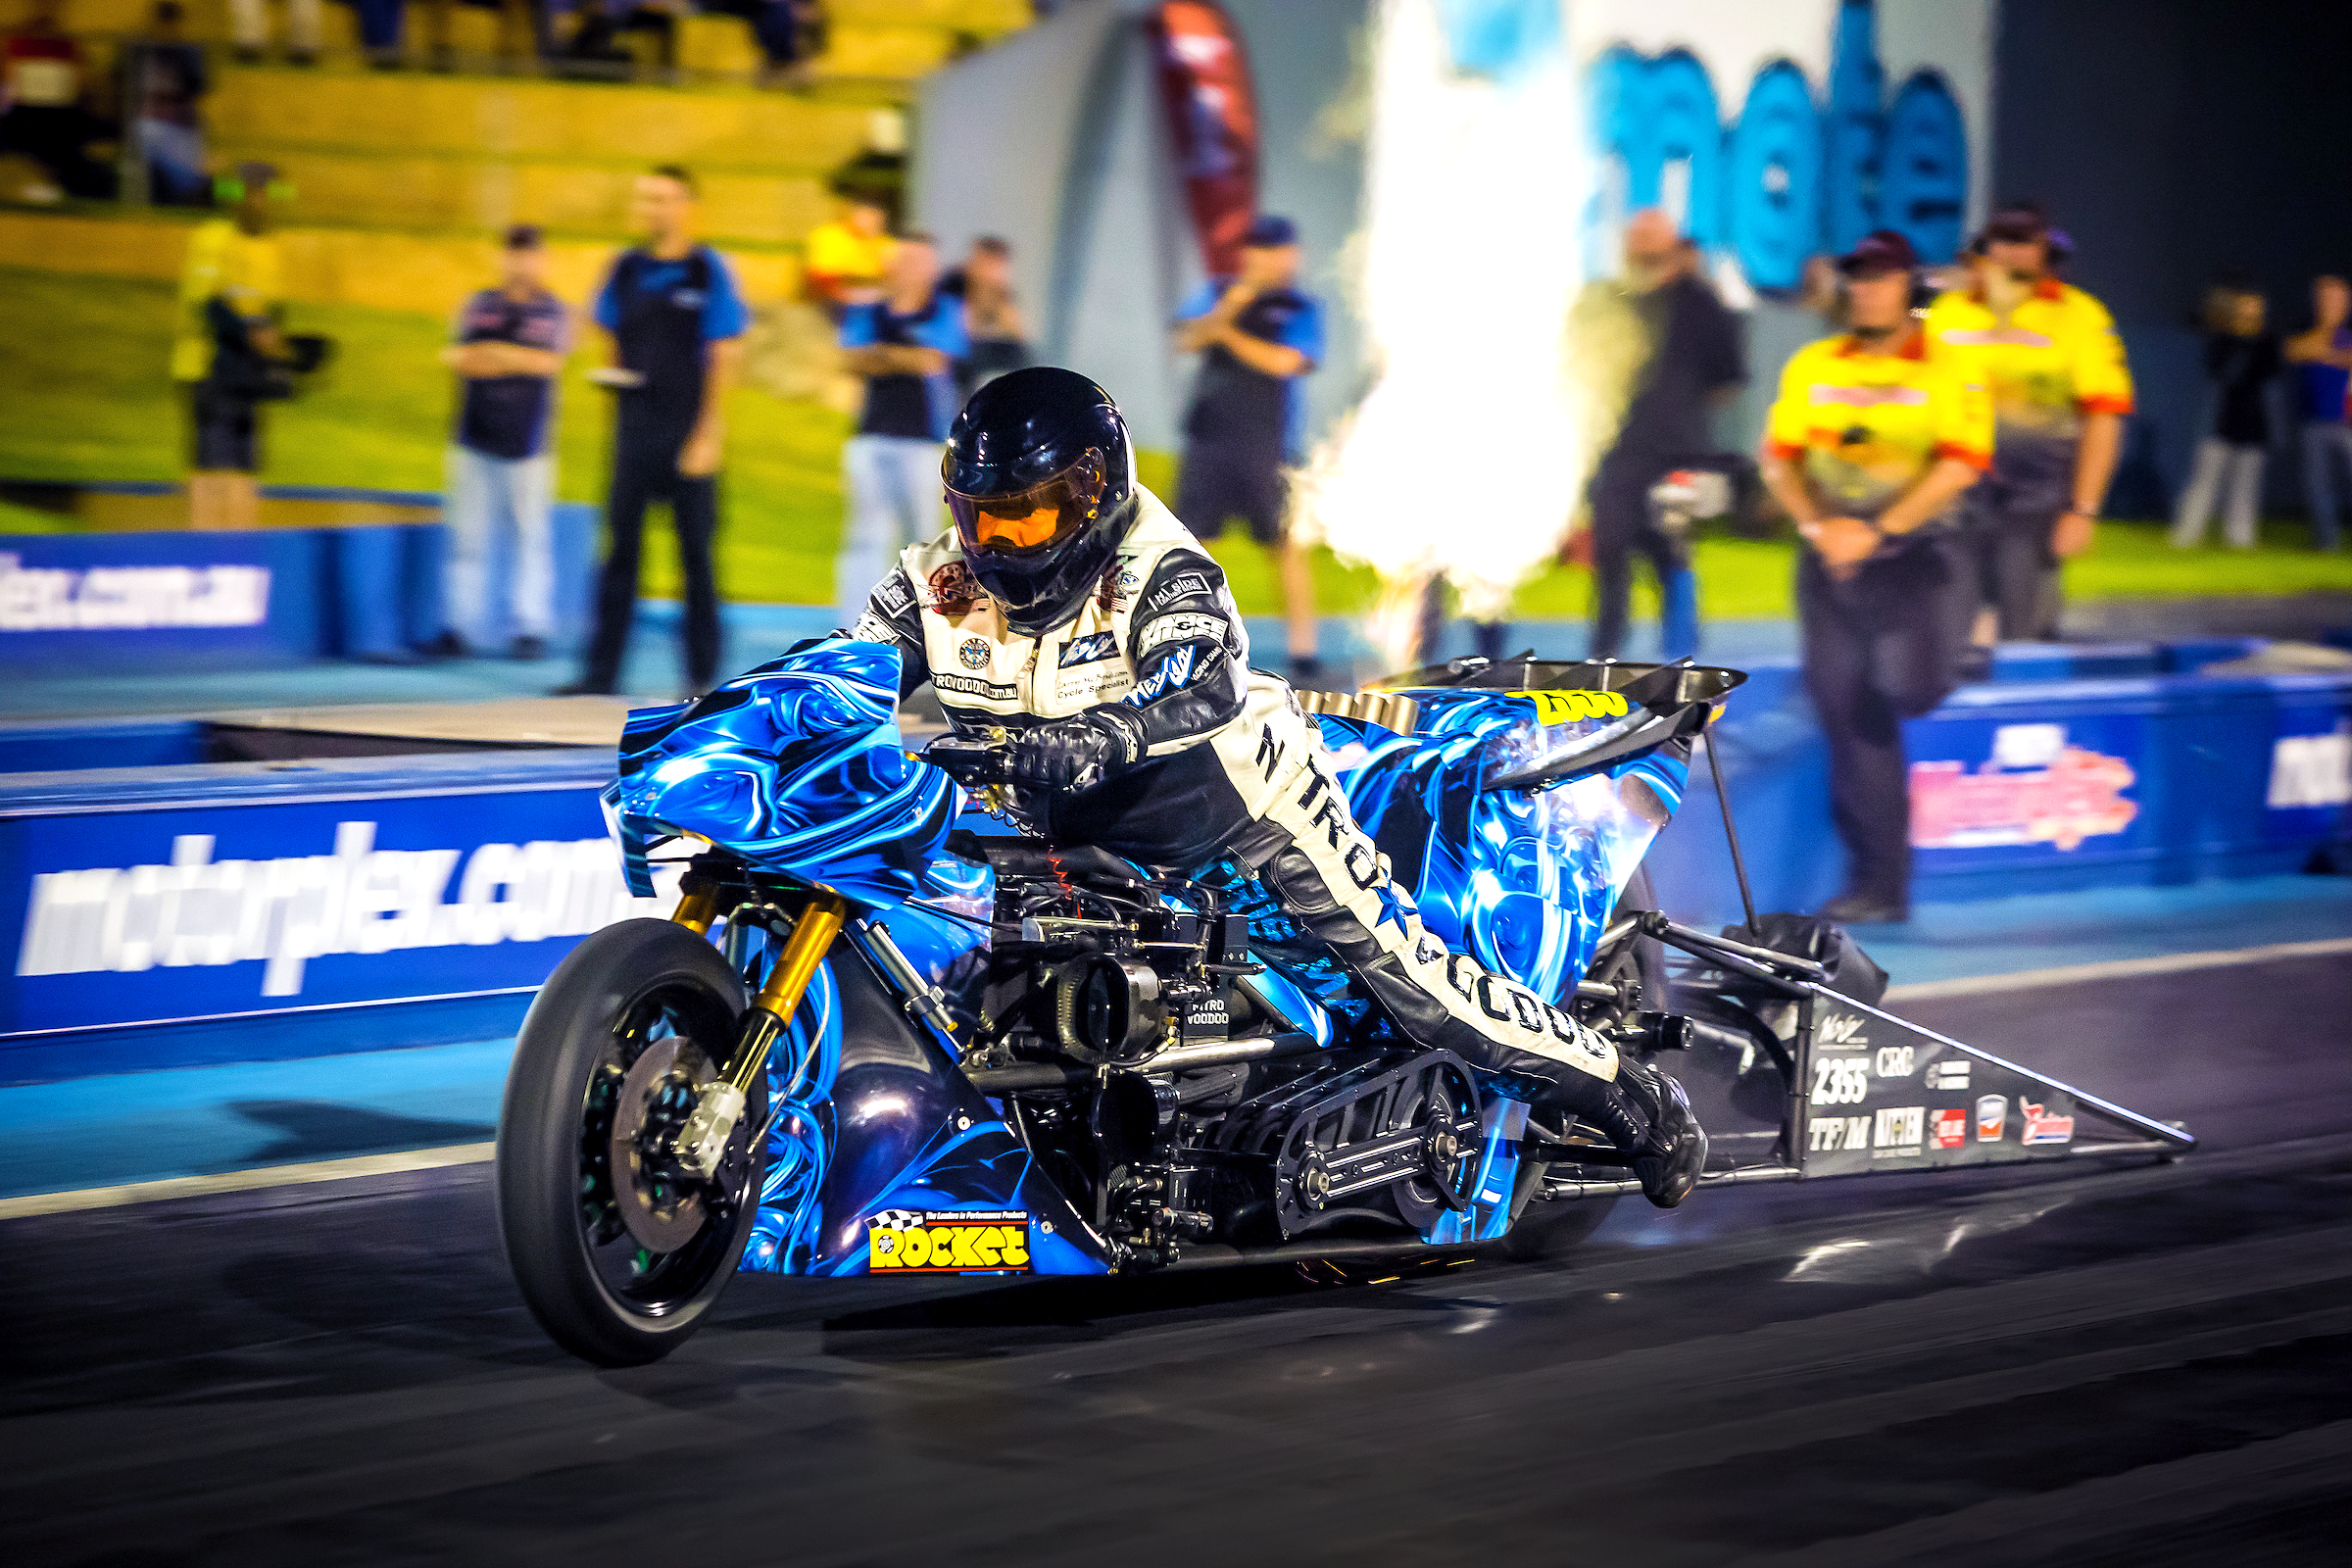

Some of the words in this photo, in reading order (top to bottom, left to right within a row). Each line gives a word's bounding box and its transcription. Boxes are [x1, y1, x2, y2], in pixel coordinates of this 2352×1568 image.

[1057, 689, 1083, 699] Cycle
[1255, 722, 1378, 891] NTRO
[1187, 1012, 1229, 1025] VOODOO
[1812, 1057, 1870, 1104] 2355
